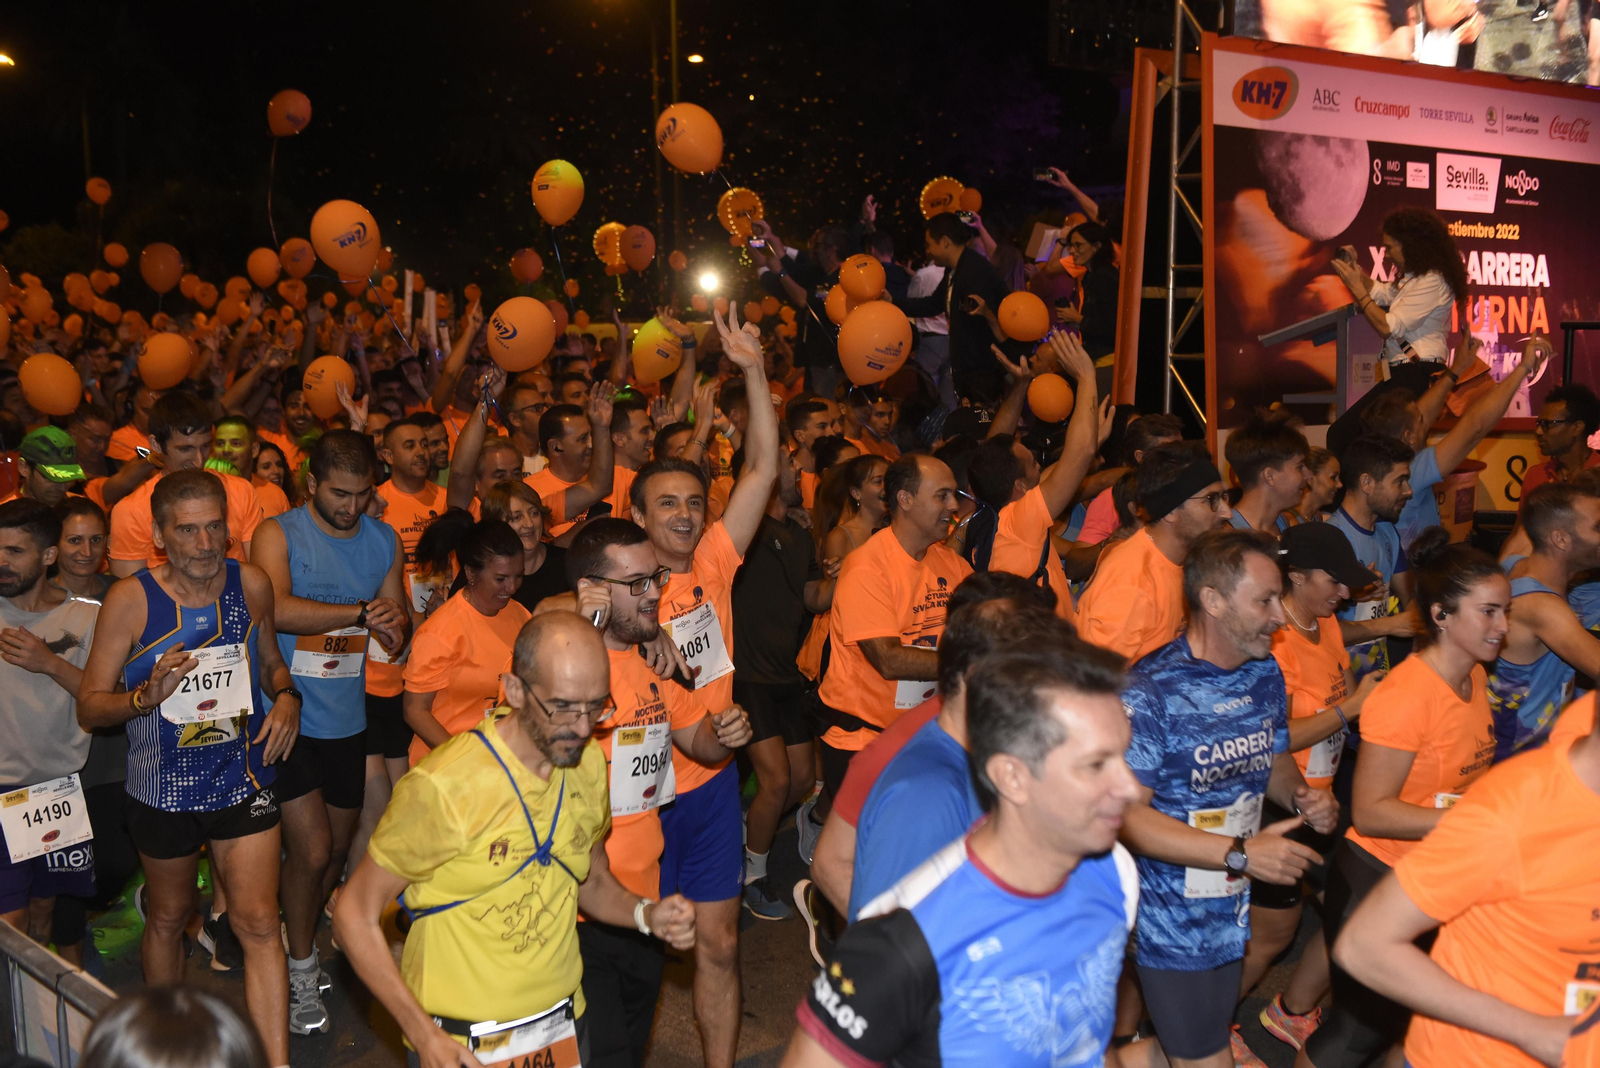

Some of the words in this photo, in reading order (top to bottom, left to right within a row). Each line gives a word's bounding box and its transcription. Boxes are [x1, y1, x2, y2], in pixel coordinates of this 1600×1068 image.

[1313, 88, 1341, 107] ABC
[1355, 95, 1410, 120] Cruzcampo
[1419, 107, 1443, 121] TORRE
[1444, 109, 1474, 125] SEVILLA
[1387, 160, 1400, 172] IMD
[339, 229, 361, 248] KH7
[1495, 223, 1520, 240] 2022
[1462, 250, 1550, 287] ARRERA
[492, 317, 510, 335] KH7
[308, 582, 340, 590] CARRERA
[324, 637, 348, 652] 882
[181, 670, 233, 693] 21677
[635, 702, 665, 718] NOCTURNA
[201, 734, 224, 744] SEVILLA
[23, 801, 71, 827] 14190
[250, 804, 277, 818] Sevilla
